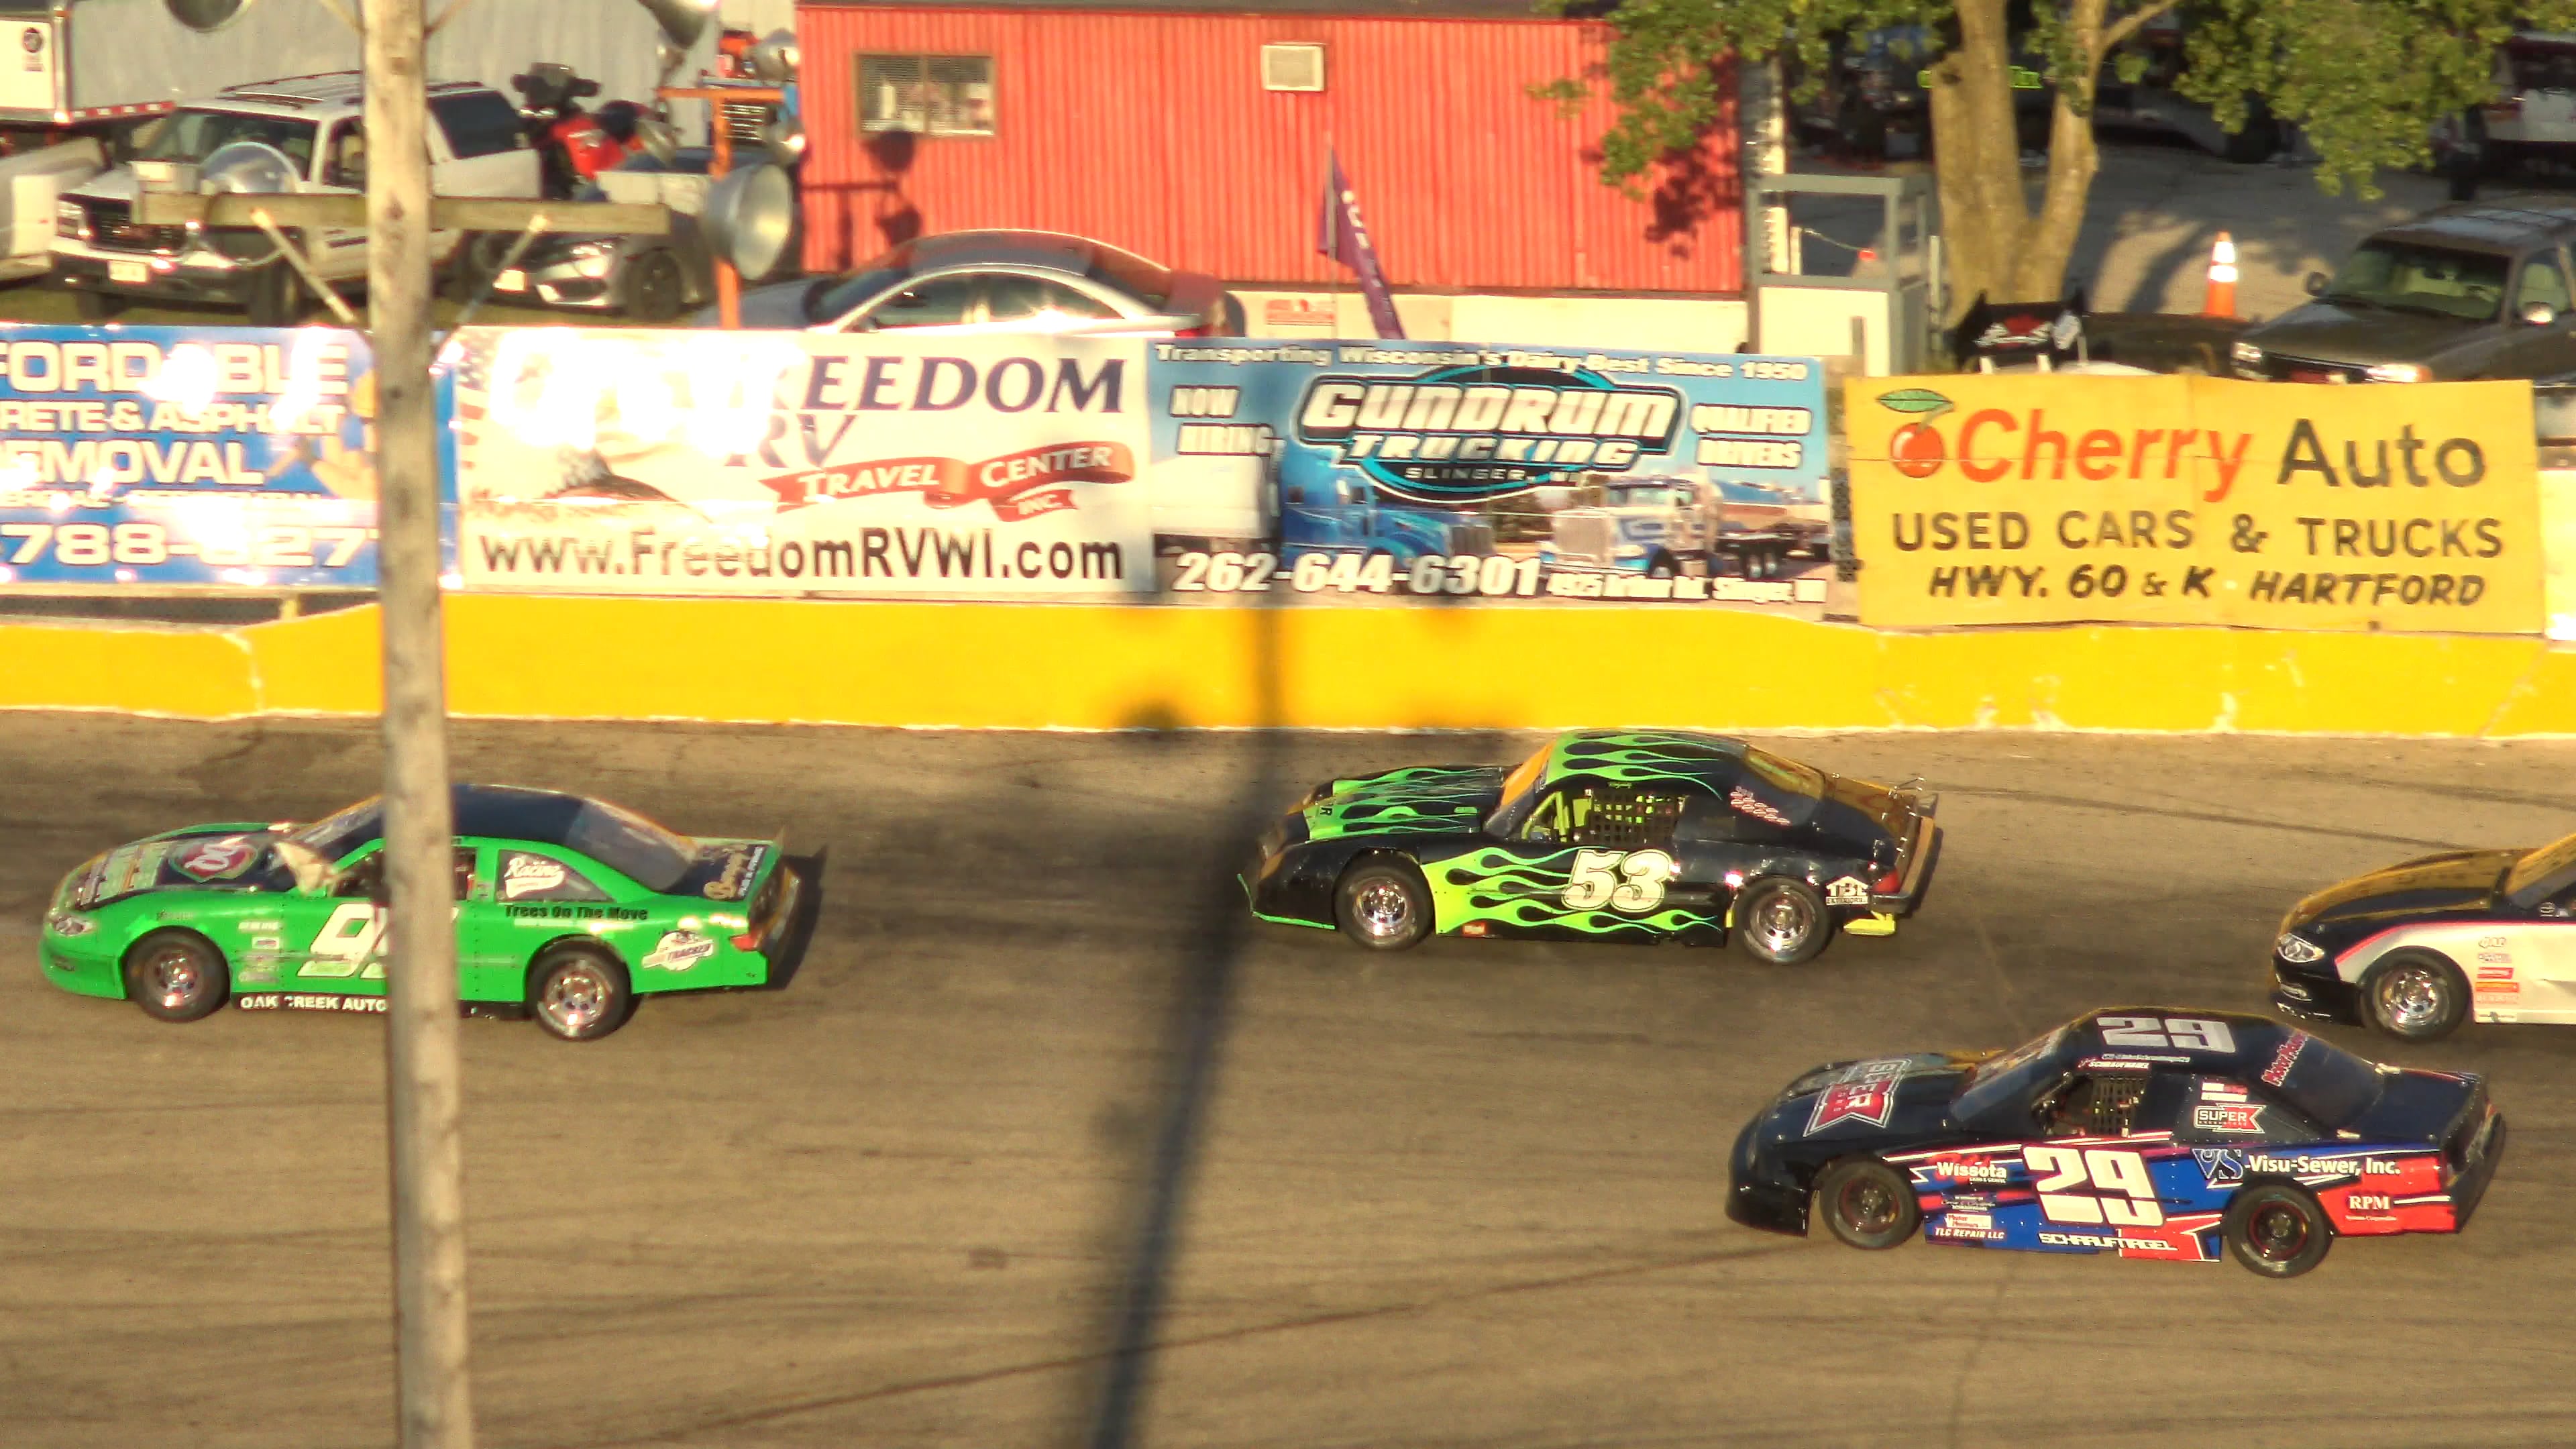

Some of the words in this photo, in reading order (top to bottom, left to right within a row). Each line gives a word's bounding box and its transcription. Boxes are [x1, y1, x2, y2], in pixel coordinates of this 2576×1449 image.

[0, 340, 349, 394] ORDBLE
[1656, 357, 1733, 377] Since
[109, 401, 143, 432] &
[150, 402, 345, 433] ASPHLT
[1300, 381, 1680, 443] GUNDRUM
[796, 464, 940, 503] TRAVEL
[981, 445, 1114, 487] CENTER
[1957, 409, 2252, 502] Cherry
[2276, 419, 2487, 488] Auto
[1893, 511, 2029, 551] USED
[2057, 510, 2194, 549] CARS
[2231, 514, 2269, 553] &
[2297, 517, 2504, 558] TRUCKS
[1174, 550, 1540, 595] 262-644-6301
[1927, 566, 2050, 598] HWY.
[2066, 565, 2128, 598] 60
[2143, 573, 2168, 597] &
[2182, 567, 2215, 597] K
[2249, 570, 2486, 606] HARTFORD
[1561, 847, 1676, 913] 53
[505, 905, 548, 918] Trees
[240, 995, 280, 1010] OAK
[342, 998, 388, 1013] AUTO
[2096, 1016, 2237, 1054] 29
[2198, 1110, 2247, 1123] SUPER
[1937, 1161, 2007, 1179] Wissota
[2249, 1155, 2361, 1177] Visu-Sewer,
[2366, 1159, 2401, 1176] Inc.
[2024, 1146, 2164, 1227] 29
[2348, 1195, 2390, 1210] RPM
[1935, 1228, 1951, 1236] TLC
[1953, 1229, 1986, 1238] REPAIR
